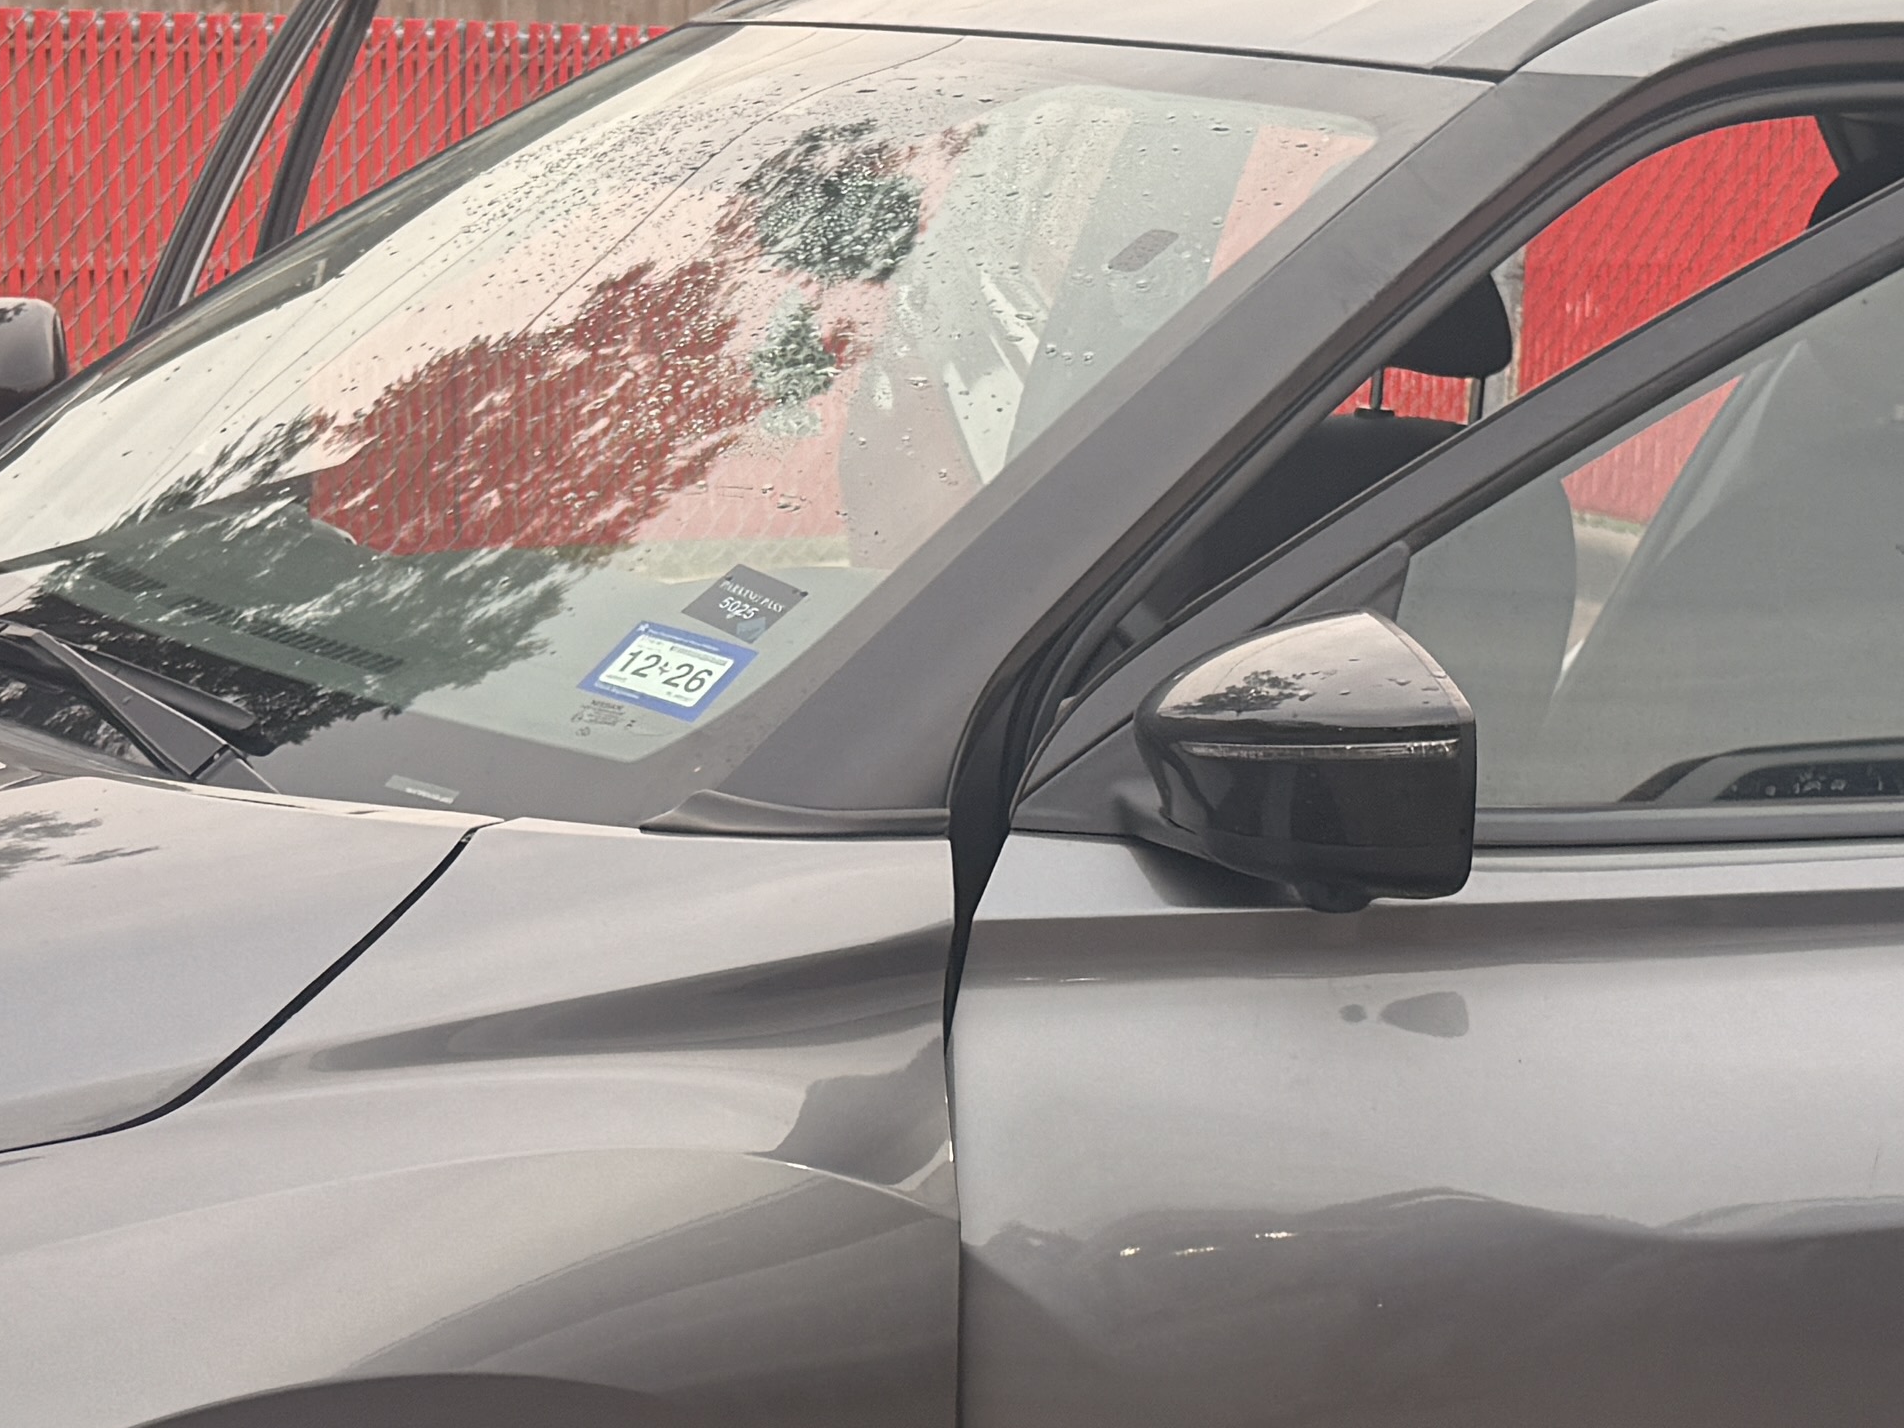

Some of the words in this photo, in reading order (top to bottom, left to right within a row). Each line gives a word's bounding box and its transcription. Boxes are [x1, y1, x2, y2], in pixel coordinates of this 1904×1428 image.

[718, 596, 759, 619] 5025
[619, 649, 662, 678] 12
[661, 662, 713, 693] 26
